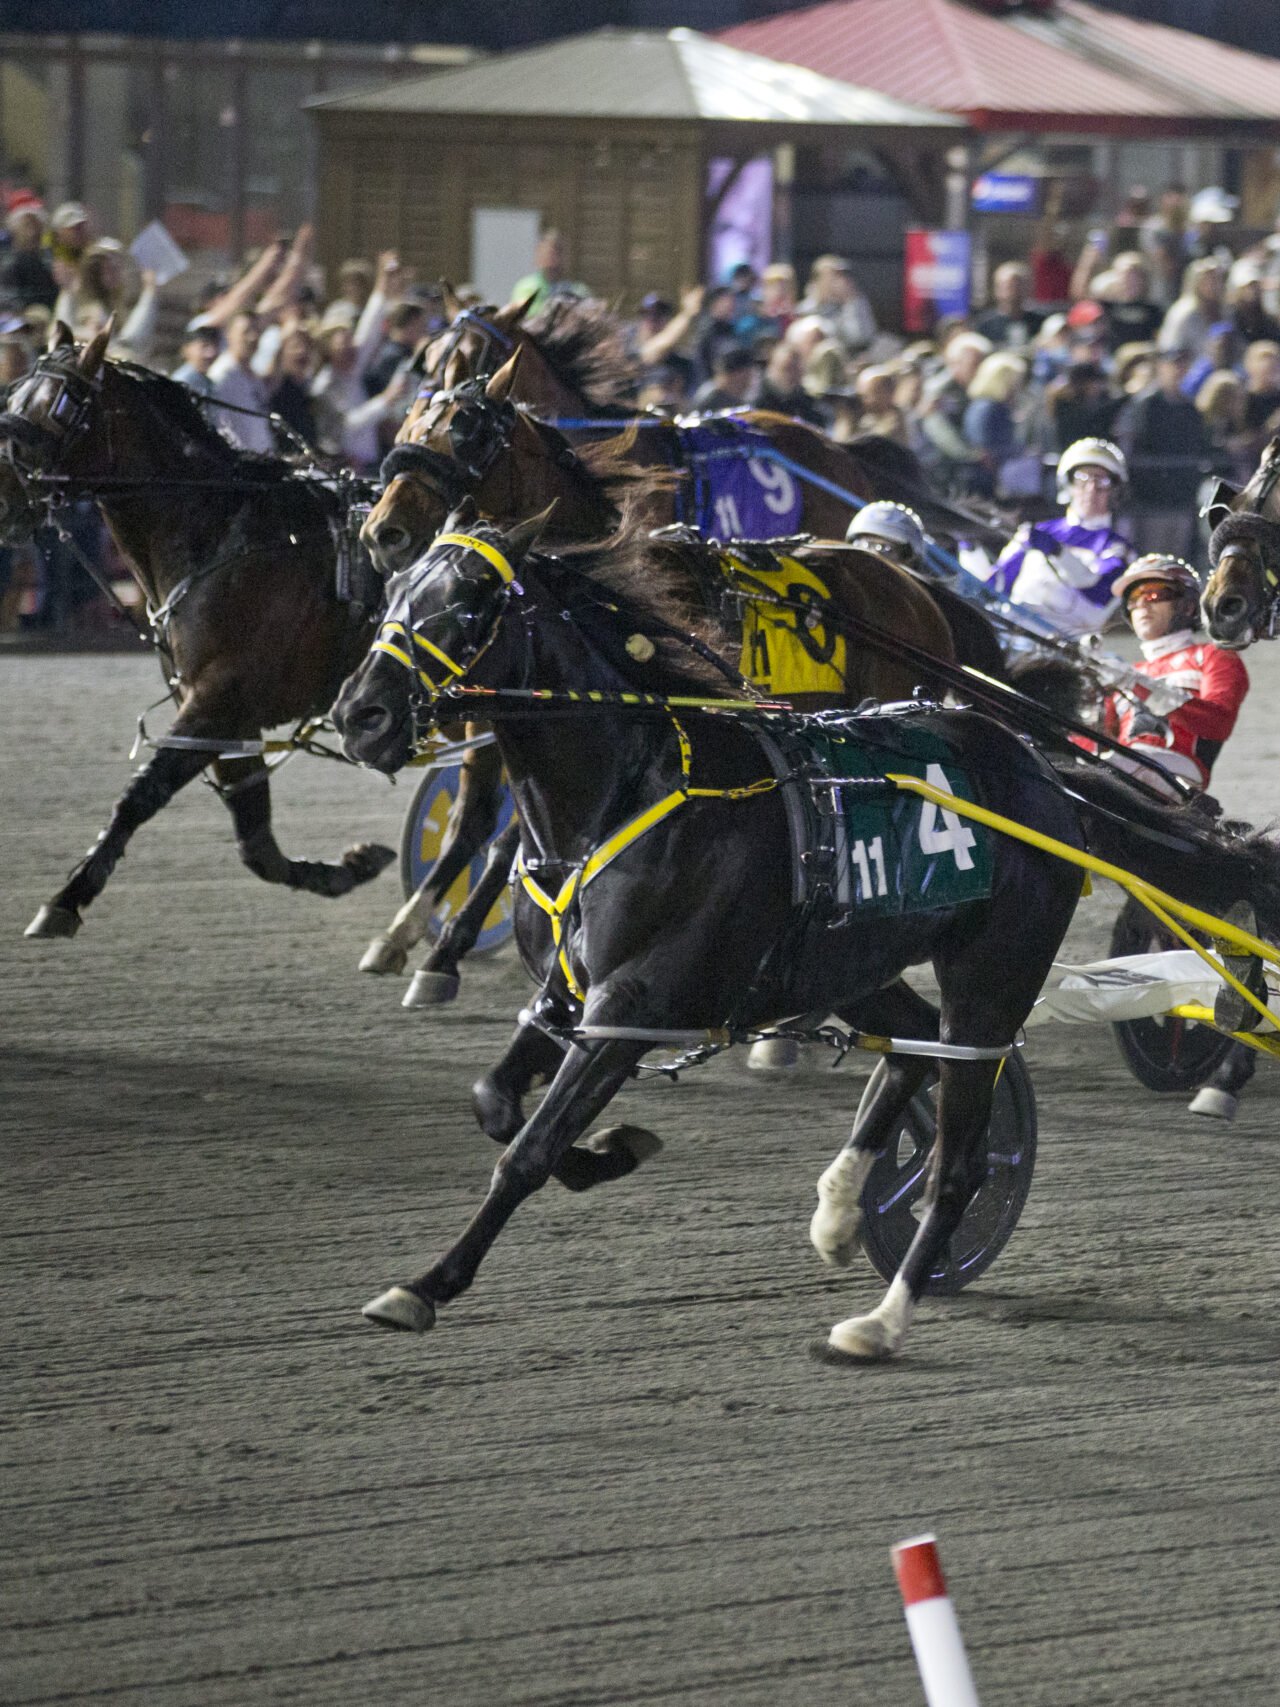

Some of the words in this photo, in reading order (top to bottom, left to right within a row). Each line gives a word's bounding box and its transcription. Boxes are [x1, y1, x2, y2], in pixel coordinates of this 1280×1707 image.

[713, 494, 743, 538] 11
[751, 455, 797, 515] 9
[919, 763, 977, 871] 4
[851, 836, 888, 900] 11
